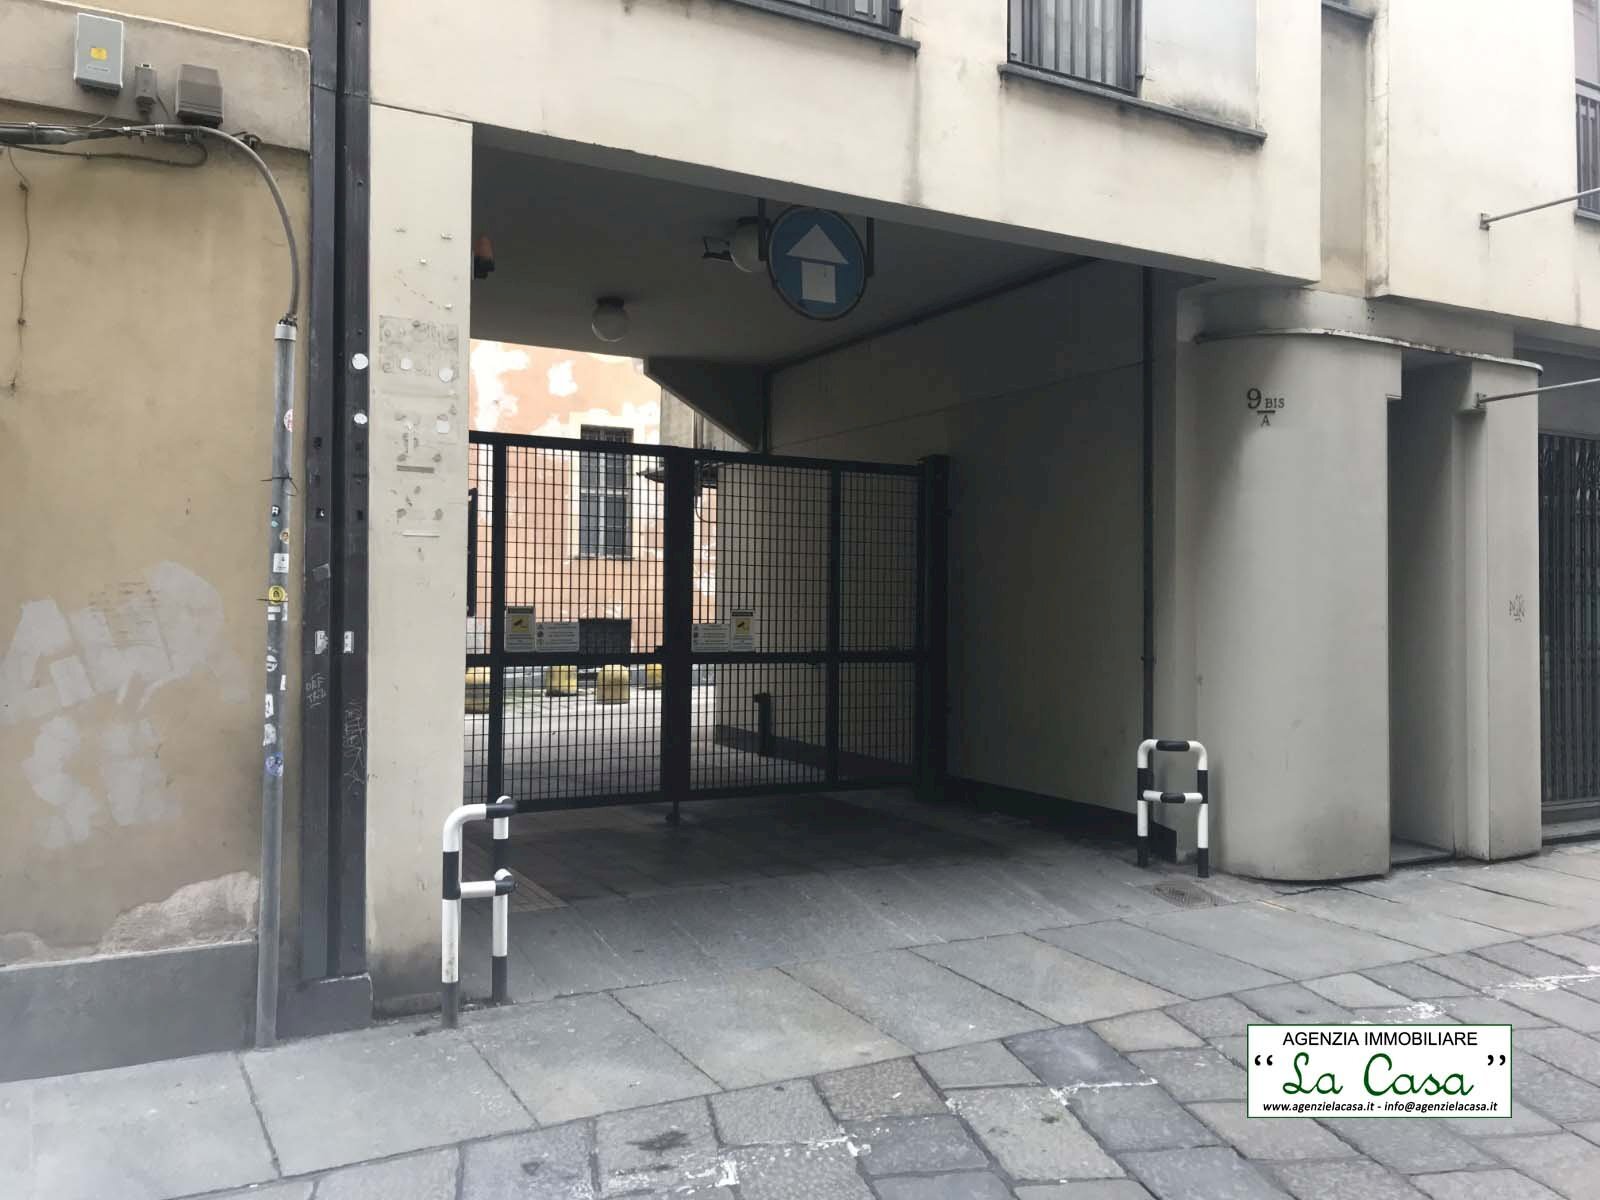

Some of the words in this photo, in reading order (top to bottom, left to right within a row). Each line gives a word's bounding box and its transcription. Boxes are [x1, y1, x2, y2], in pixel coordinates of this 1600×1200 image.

[1247, 387, 1262, 409] 9
[1265, 398, 1285, 409] BIS
[1260, 414, 1271, 427] A
